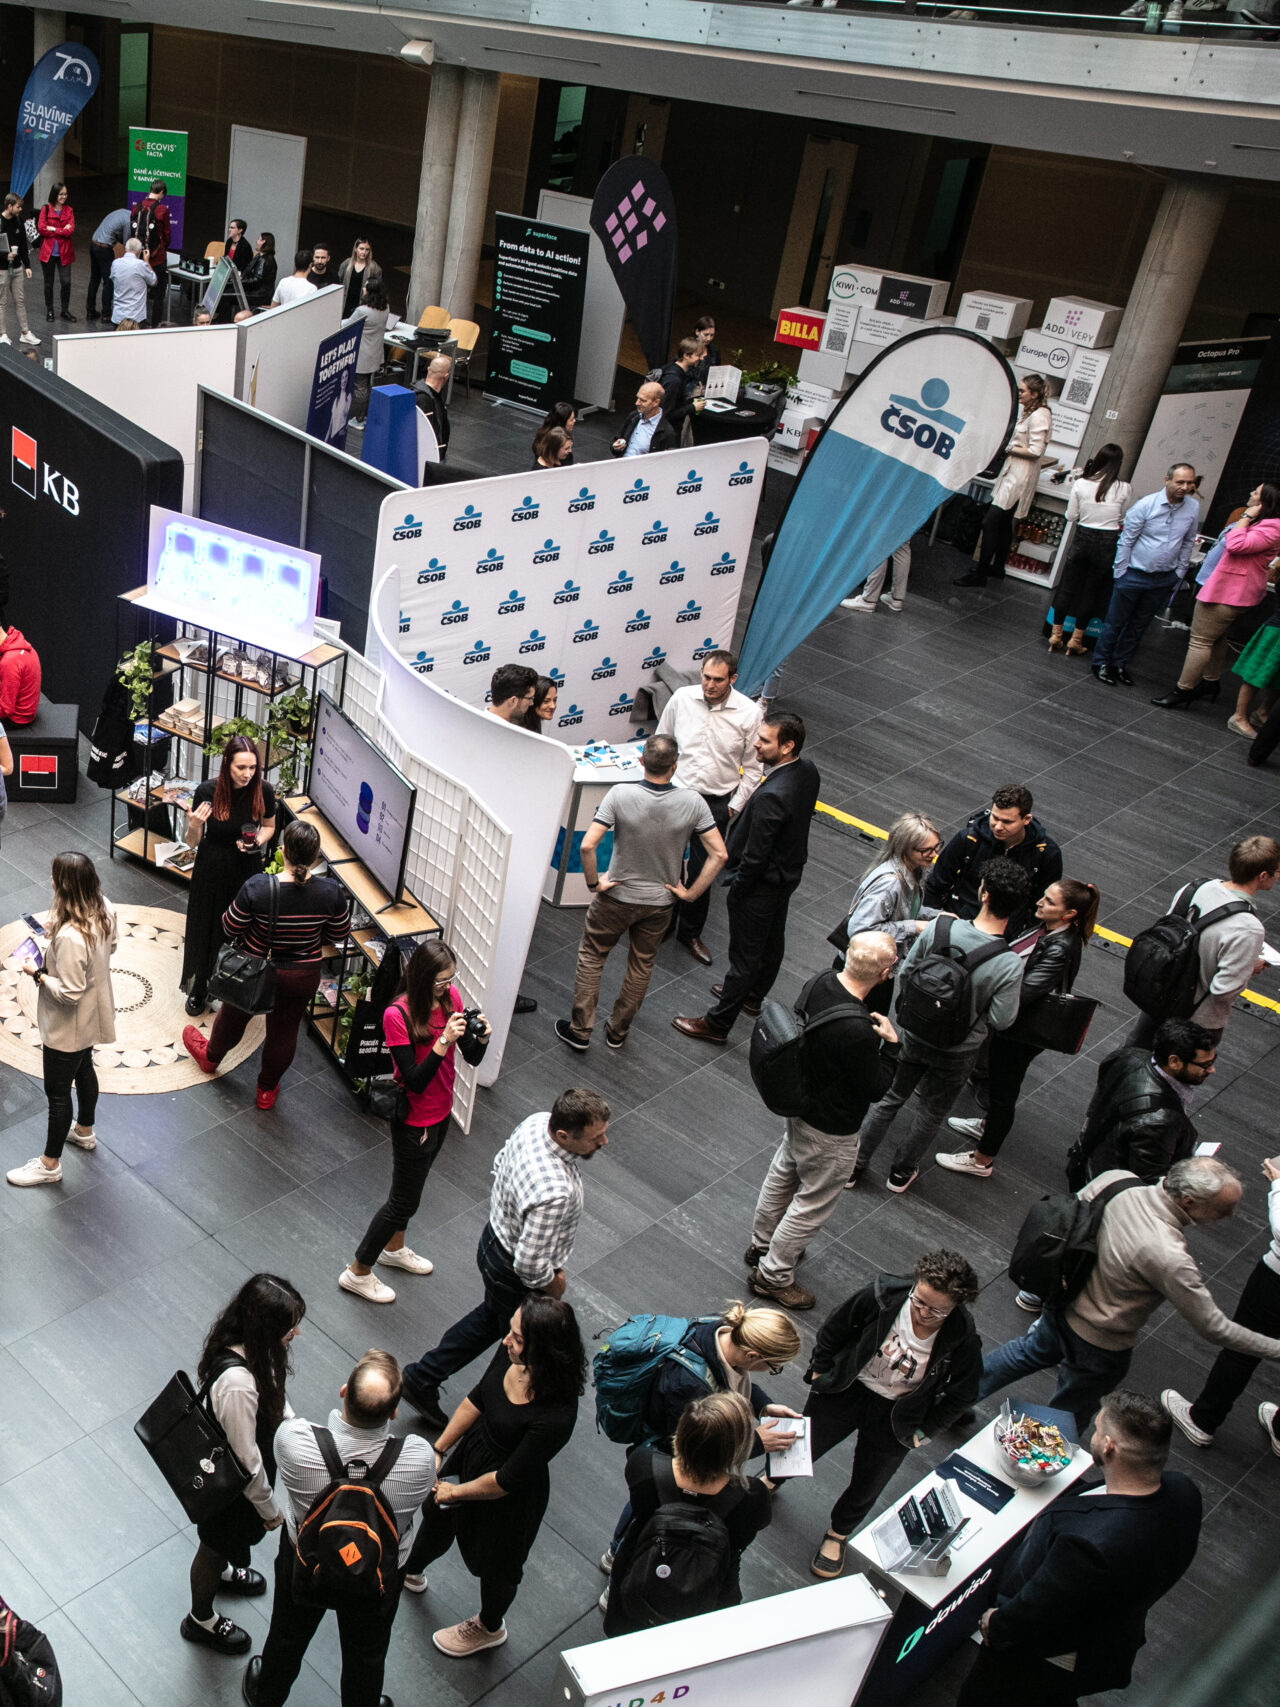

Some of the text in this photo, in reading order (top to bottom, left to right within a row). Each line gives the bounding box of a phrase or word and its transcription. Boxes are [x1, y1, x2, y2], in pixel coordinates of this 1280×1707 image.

[24, 101, 73, 127] SLAVÍME
[23, 114, 59, 134] 70 LET
[532, 231, 558, 241] superface
[499, 240, 581, 265] From data to AI action!
[836, 280, 878, 296] KIWI COM
[779, 320, 818, 342] BILLA
[1045, 323, 1094, 343] ADD VERY
[320, 336, 357, 368] LET'S PLAY
[1021, 345, 1067, 363] Europe IVF
[1197, 350, 1226, 358] Octopus
[786, 427, 801, 437] KB
[880, 404, 956, 460] ČSOB
[728, 476, 753, 487] ČSOB
[43, 461, 80, 516] KB
[676, 484, 702, 495] ČSOB
[623, 493, 649, 504] ČSOB
[568, 501, 595, 513] ČSOB
[511, 510, 539, 522] ČSOB
[453, 519, 481, 532] ČSOB
[693, 525, 719, 537] ČSOB
[393, 529, 422, 541] ČSOB
[641, 534, 667, 545] ČSOB
[588, 543, 614, 555] ČSOB
[532, 552, 560, 565] ČSOB
[475, 562, 504, 574] ČSOB
[710, 565, 735, 576] ČSOB
[417, 572, 446, 585] ČSOB
[659, 574, 685, 585] ČSOB
[607, 584, 633, 595] ČSOB
[553, 593, 580, 605] ČSOB
[498, 603, 525, 615] ČSOB
[440, 613, 469, 626] ČSOB
[675, 612, 701, 624] ČSOB
[625, 622, 650, 634] ČSOB
[572, 632, 598, 644] ČSOB
[518, 642, 545, 654] ČSOB
[463, 653, 490, 665] ČSOB
[591, 669, 616, 681] ČSOB
[609, 705, 633, 716] ČSOB
[558, 716, 583, 728] ČSOB
[925, 1568, 992, 1635] dawiso
